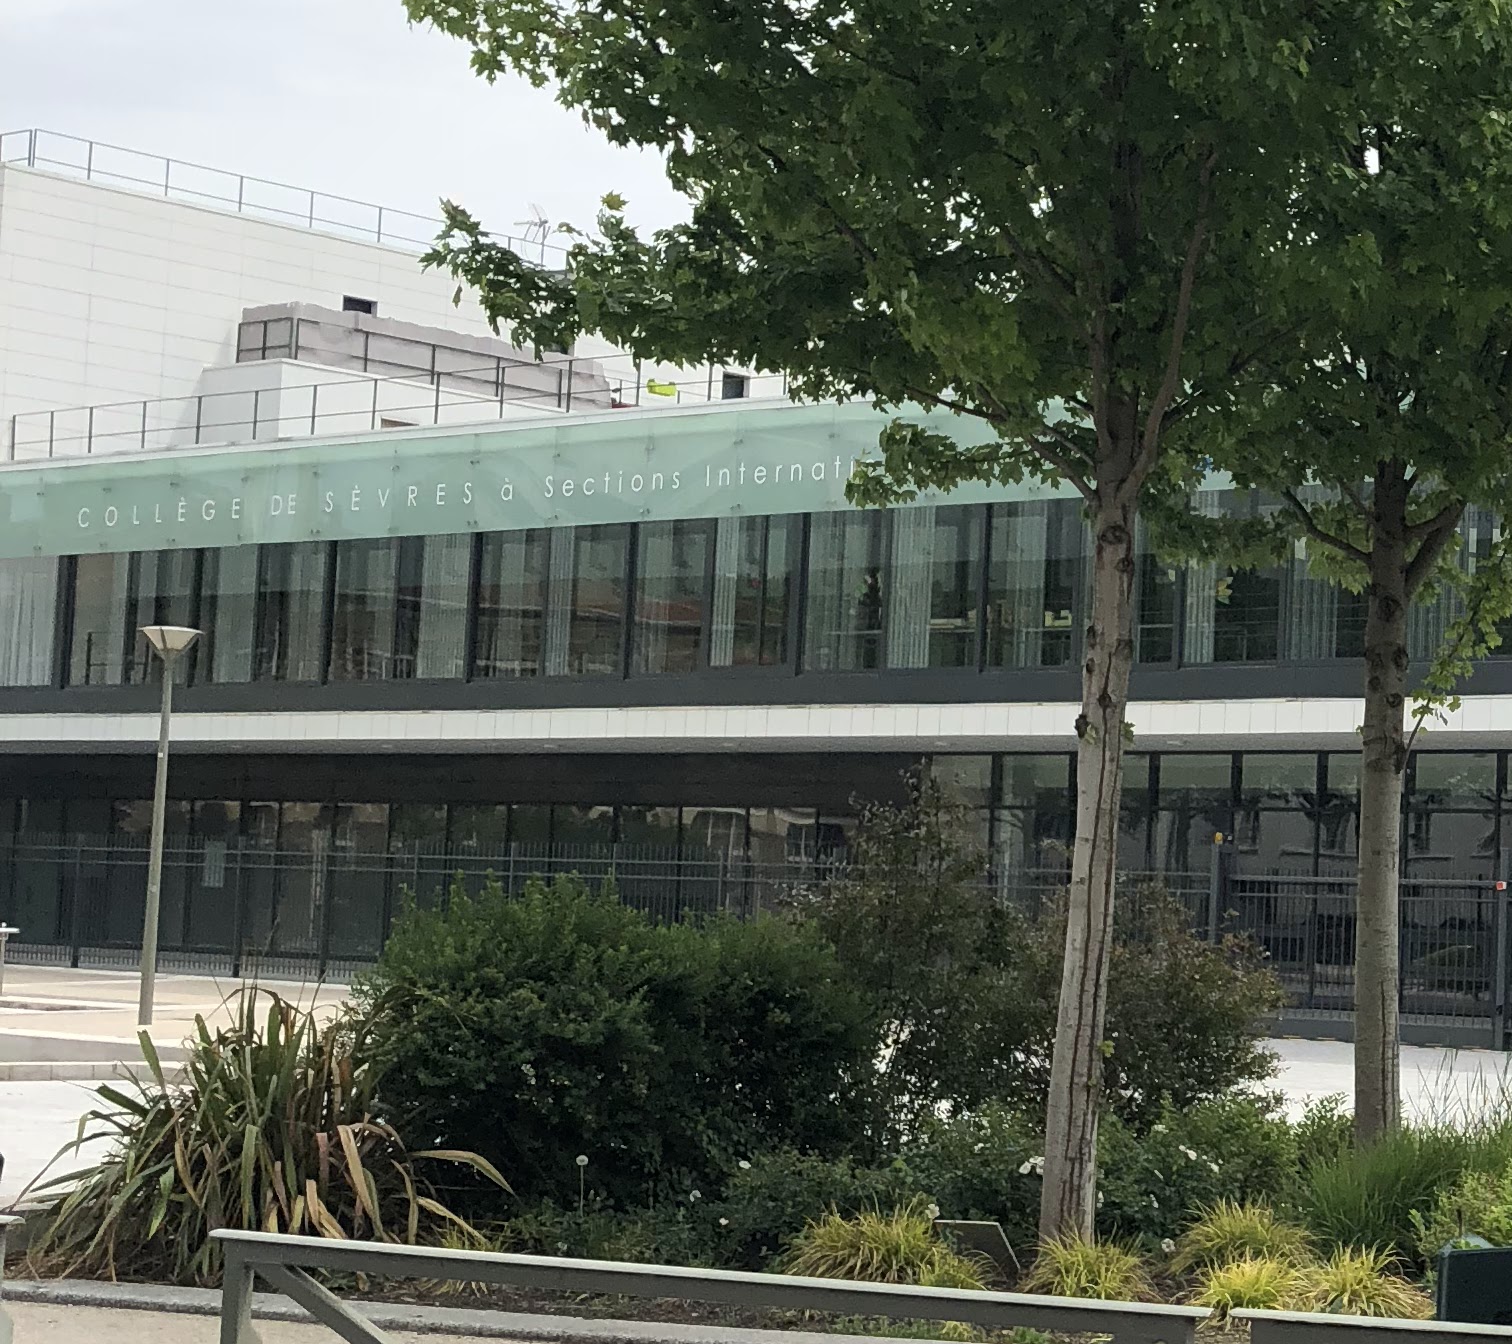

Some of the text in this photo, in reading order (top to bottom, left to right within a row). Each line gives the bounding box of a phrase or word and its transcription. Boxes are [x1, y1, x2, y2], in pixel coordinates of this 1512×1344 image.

[78, 455, 878, 528] COLLÈGE DE SÈVRES à Sections Internati
